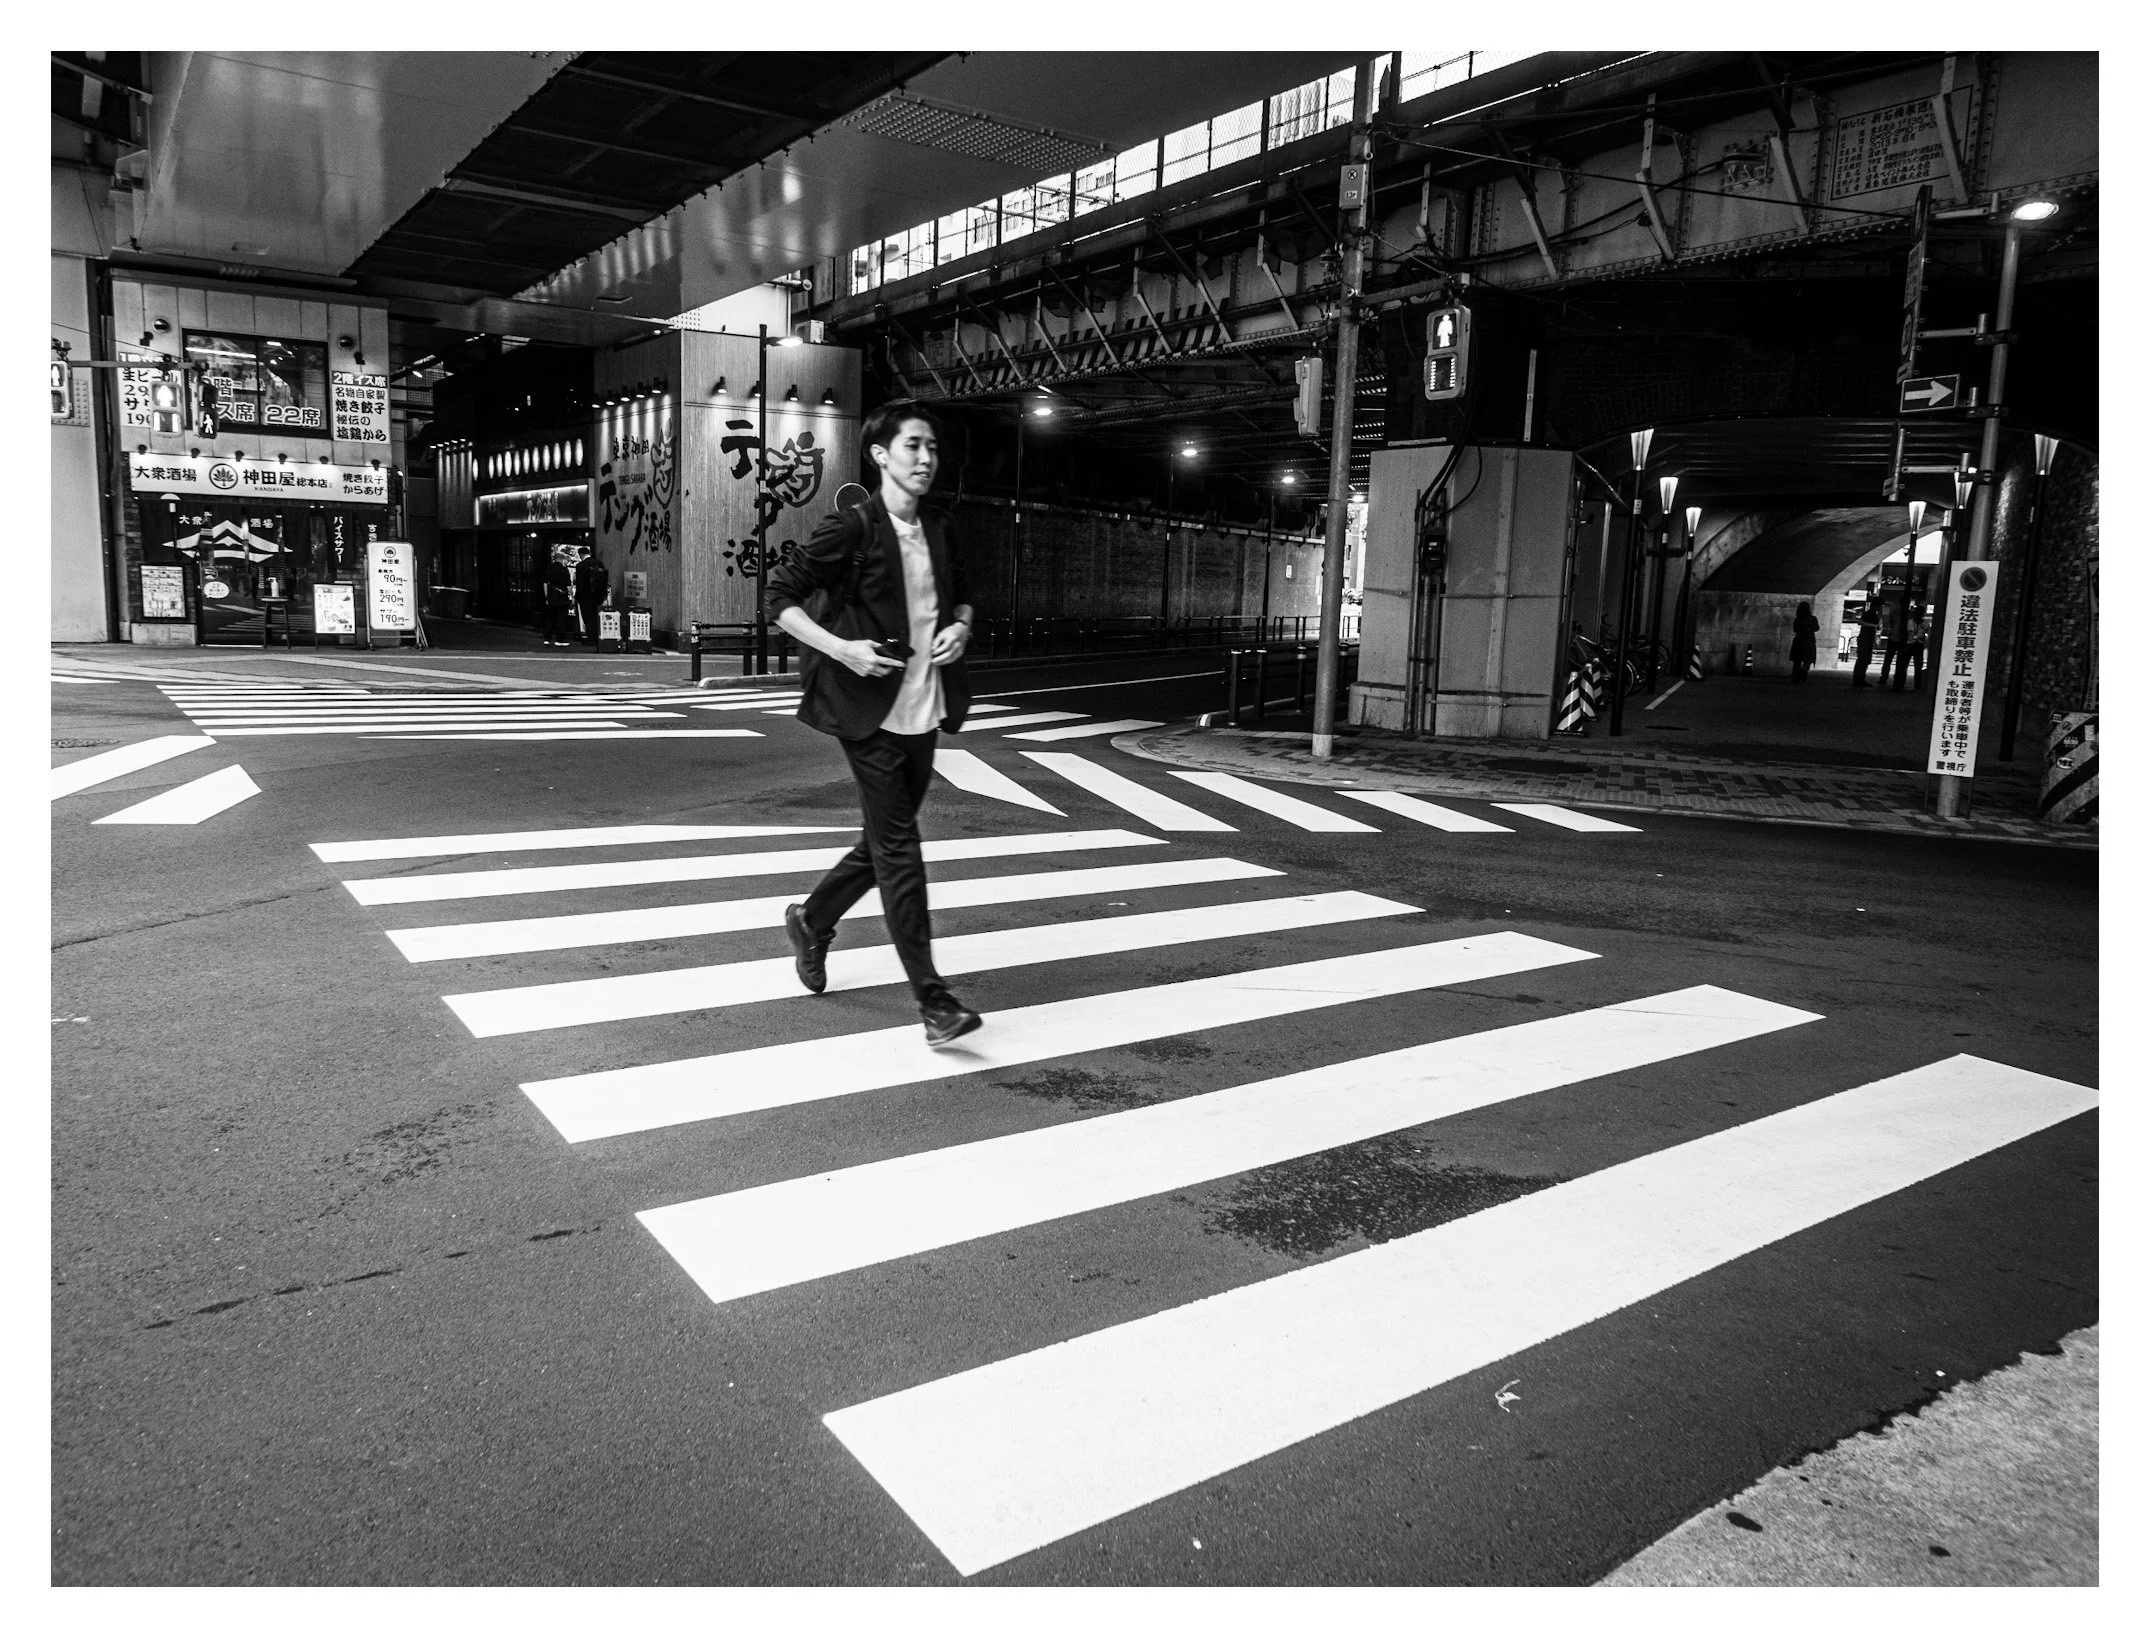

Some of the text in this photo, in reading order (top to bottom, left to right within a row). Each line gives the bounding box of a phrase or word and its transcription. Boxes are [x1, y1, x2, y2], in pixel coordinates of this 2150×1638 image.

[266, 404, 321, 426] 22席
[335, 399, 386, 415] 焼き餃子
[613, 434, 650, 462] 東京神田
[134, 466, 198, 483] 大衆酒場
[243, 469, 296, 487] 神田屋
[296, 477, 328, 489] 総本店
[342, 471, 385, 486] 焼き餃子
[343, 484, 385, 497] からあげ
[250, 518, 274, 529] 酒場
[1952, 594, 1981, 677] 違法駐車禁止
[1939, 679, 1960, 757] も取締りを行います
[1954, 680, 1975, 758] 運転者等が乗車中で
[1935, 760, 1967, 772] 警視庁
